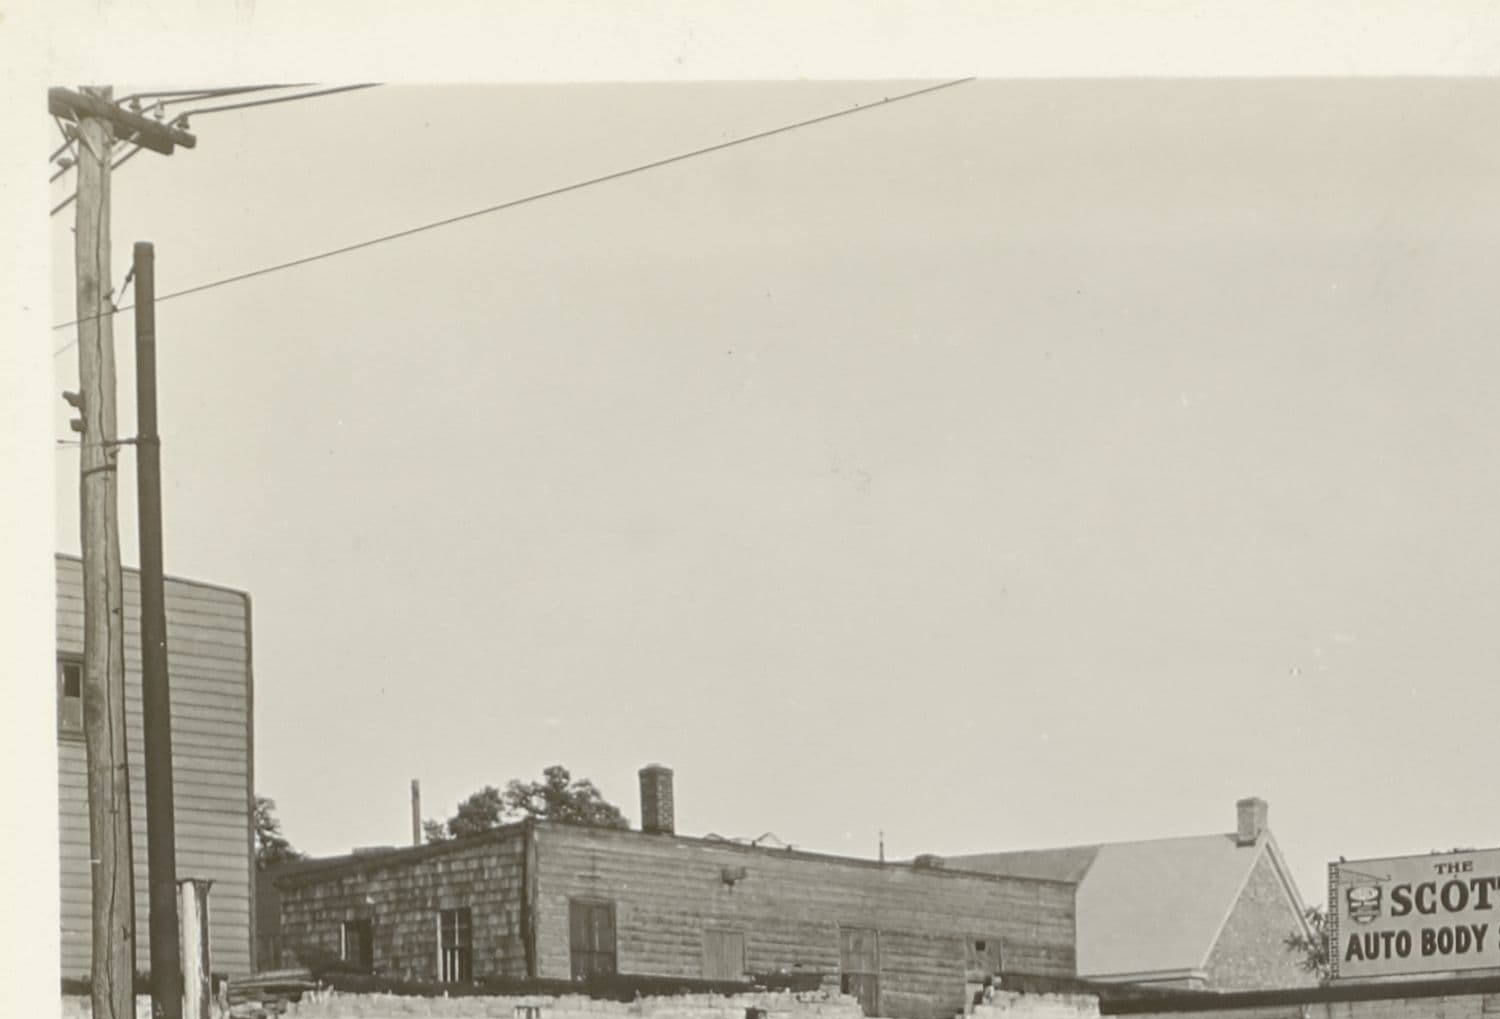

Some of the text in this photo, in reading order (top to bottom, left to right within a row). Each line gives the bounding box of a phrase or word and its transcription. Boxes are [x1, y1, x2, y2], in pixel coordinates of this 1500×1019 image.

[1433, 860, 1473, 875] THE
[1345, 929, 1412, 962] AUTO
[1421, 923, 1489, 957] BODY
